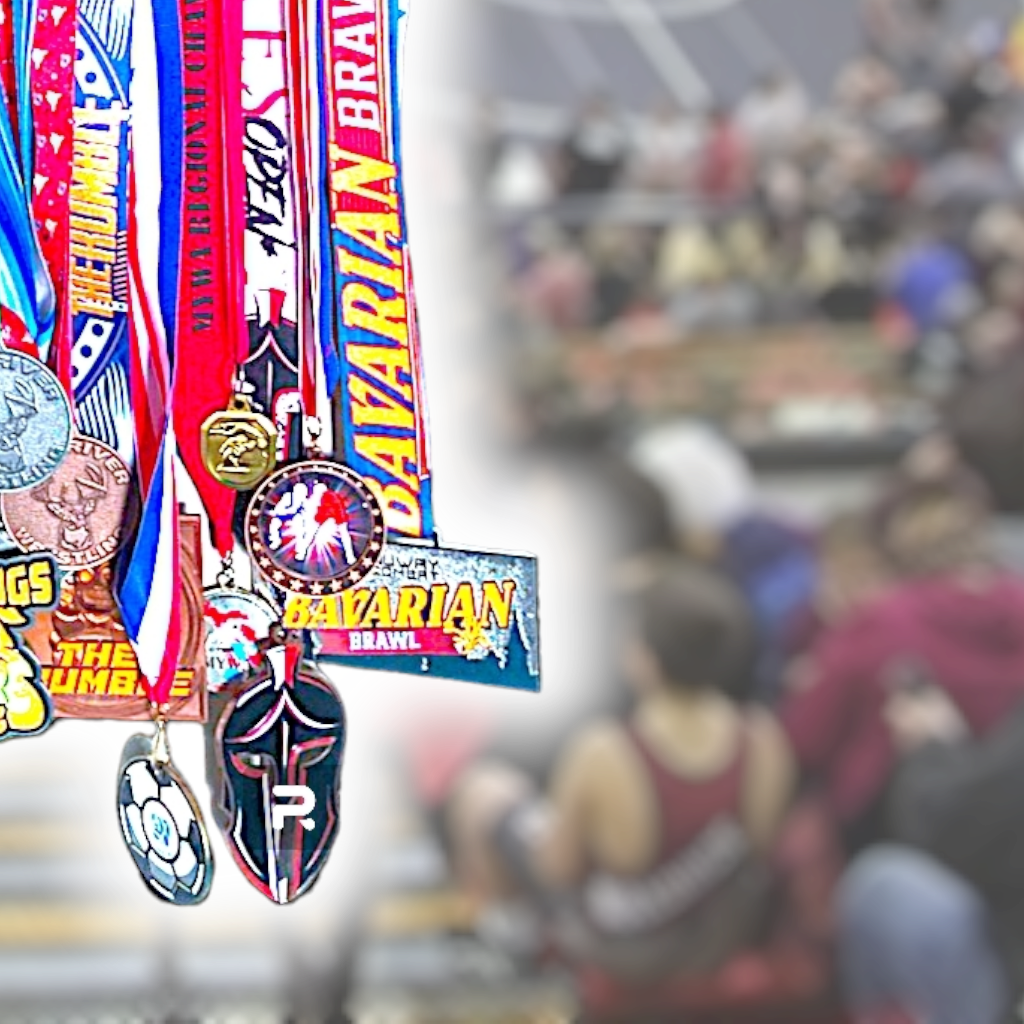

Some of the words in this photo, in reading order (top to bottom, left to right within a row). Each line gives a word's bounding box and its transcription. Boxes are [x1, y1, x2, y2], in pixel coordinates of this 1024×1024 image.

[186, 79, 211, 235] REGIONAL
[189, 242, 215, 333] MYWA
[328, 140, 423, 537] BAVARIAN
[282, 579, 516, 630] BAVARIAN
[55, 640, 138, 669] THE
[349, 630, 422, 651] BRAWL
